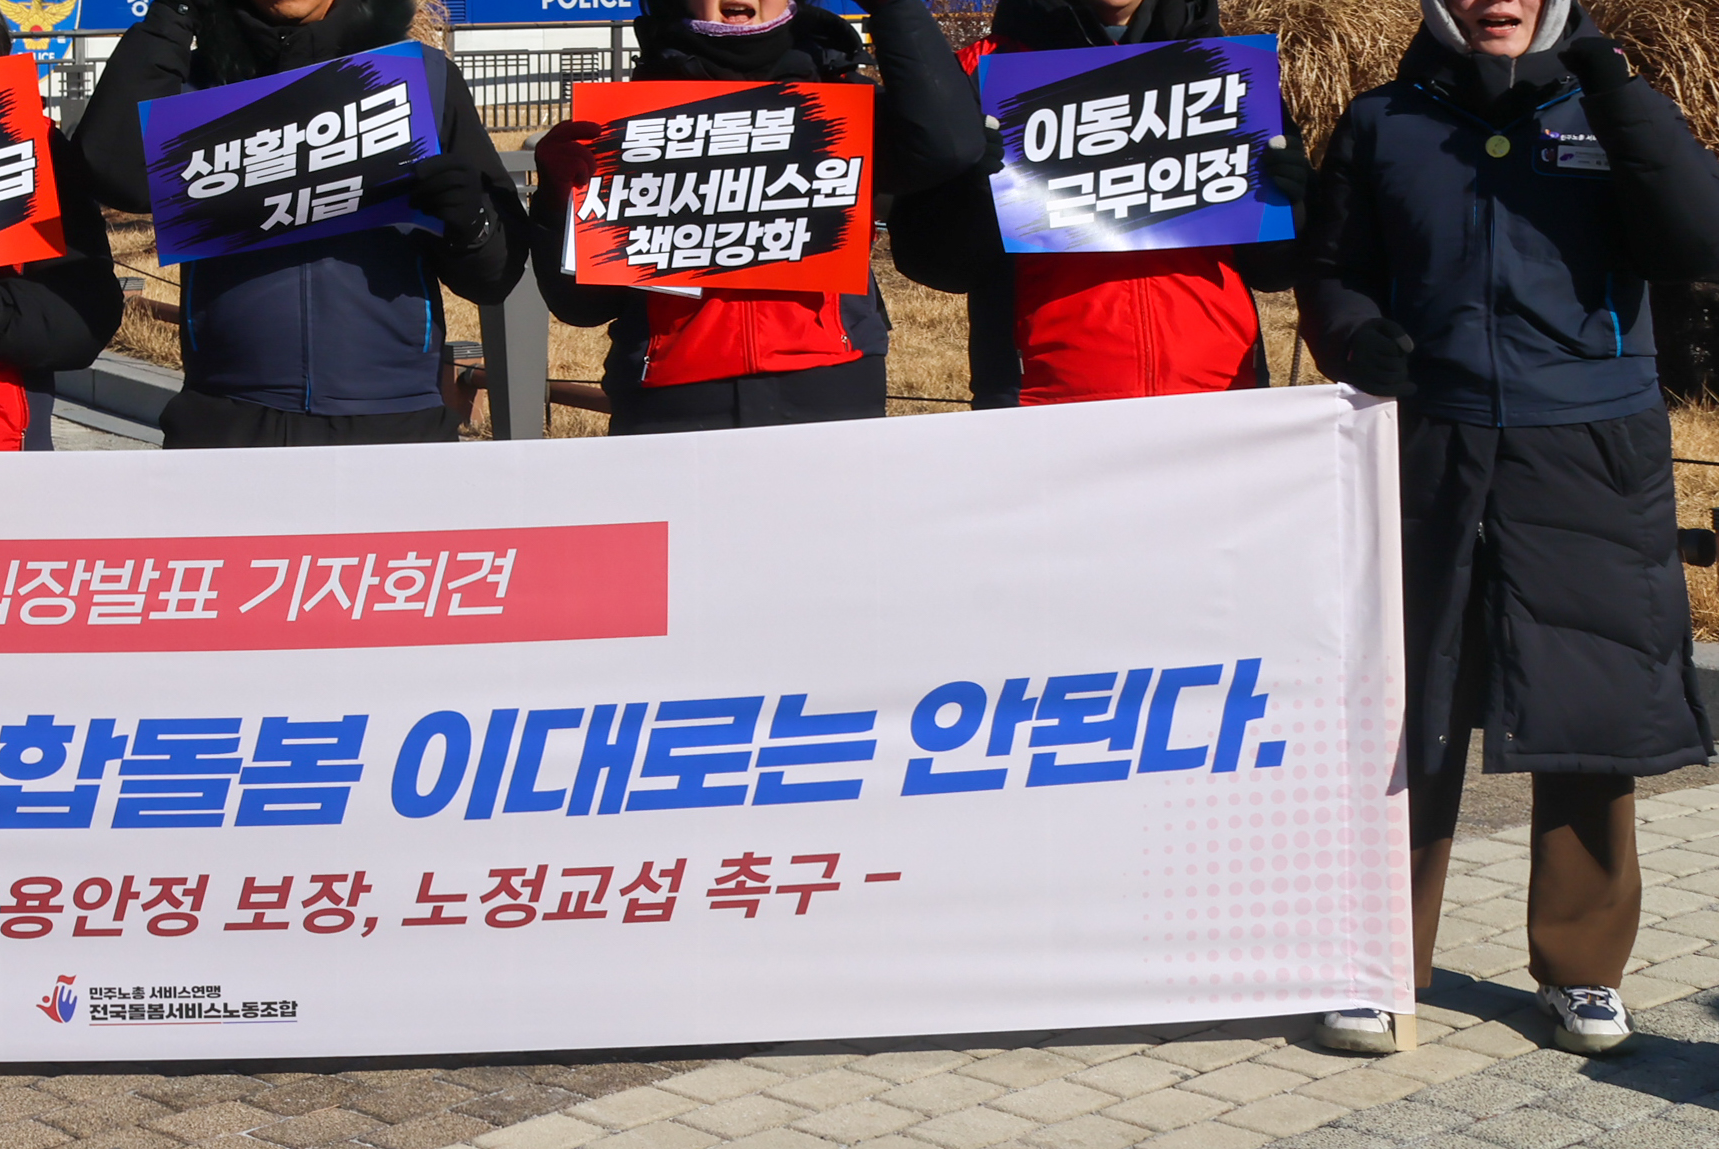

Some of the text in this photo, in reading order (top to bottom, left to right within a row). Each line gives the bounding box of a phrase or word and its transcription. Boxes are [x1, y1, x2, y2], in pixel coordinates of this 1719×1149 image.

[181, 83, 411, 199] 생활임금
[622, 107, 795, 162] 통합돌봄
[1024, 74, 1246, 162] 이동시간
[261, 176, 363, 231] 지급
[577, 158, 861, 221] 사회서비스원
[1046, 144, 1249, 229] 근무인정
[626, 218, 811, 270] 책임강화
[239, 549, 516, 621] 기자회견
[392, 694, 877, 820] 이대로는
[902, 658, 1286, 796] 안된다.
[225, 871, 377, 938] 보장,
[403, 859, 687, 928] 노정교섭
[706, 852, 840, 918] 촉구
[89, 985, 221, 1000] 민주노총 서비스연맹
[89, 1001, 298, 1021] 전국돌봄서비스노동조합
